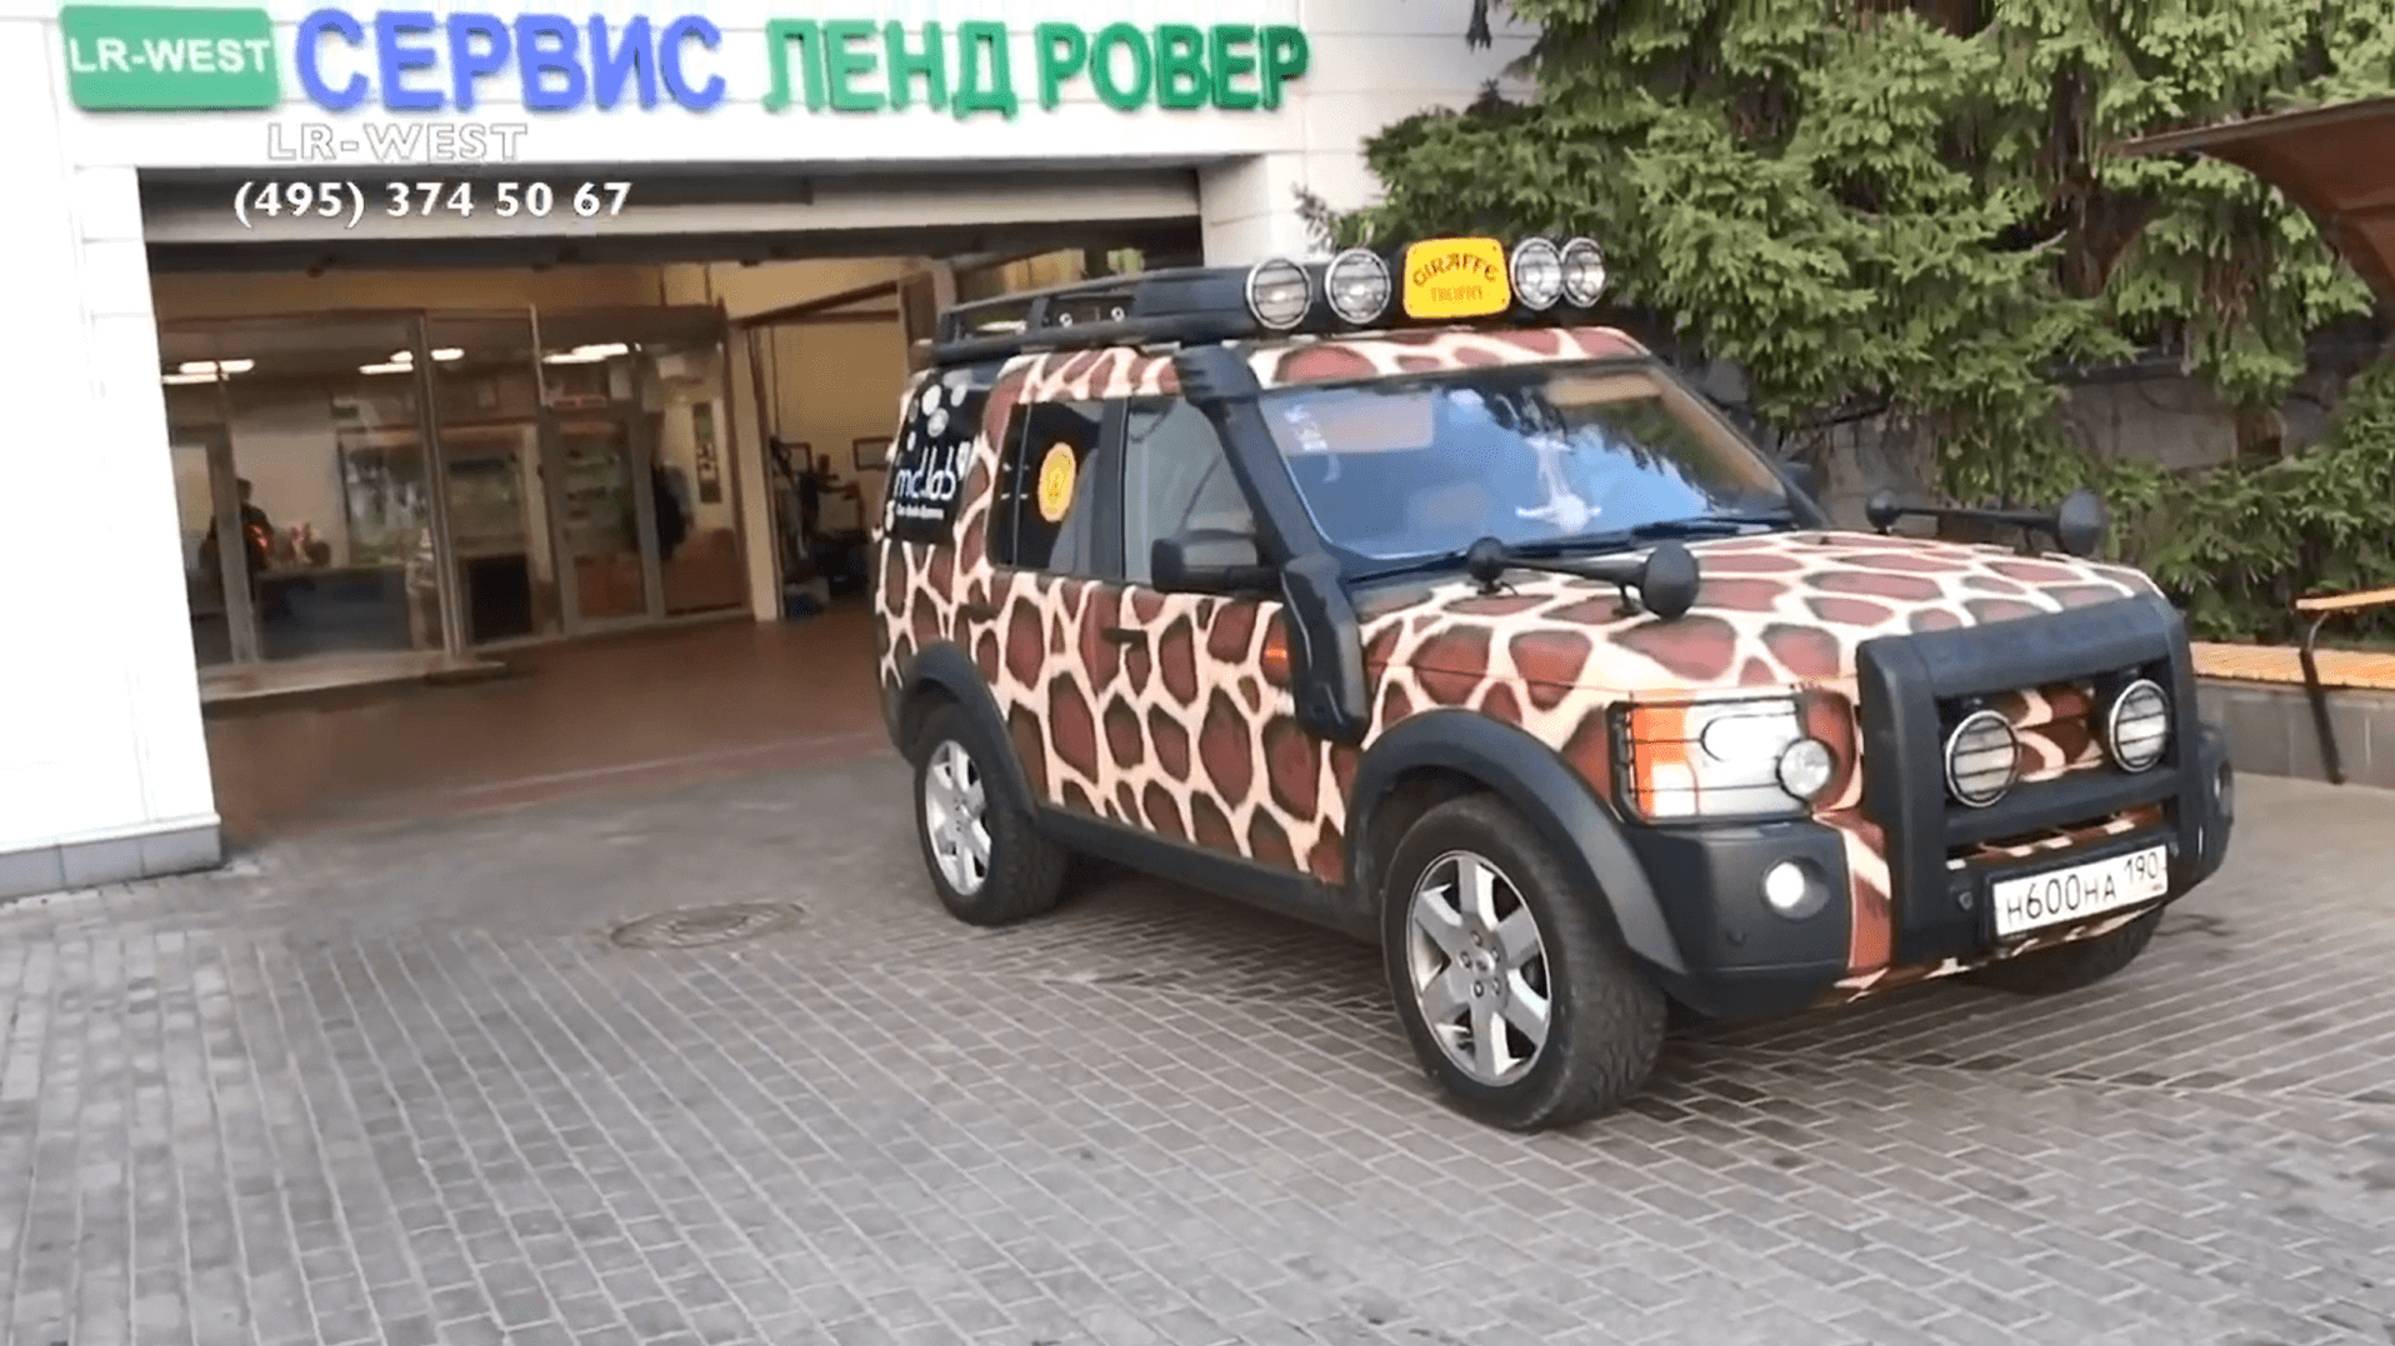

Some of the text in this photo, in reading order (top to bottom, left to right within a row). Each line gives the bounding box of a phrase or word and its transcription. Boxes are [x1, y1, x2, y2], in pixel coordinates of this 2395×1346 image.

[71, 37, 271, 74] LR-WEST
[295, 8, 1310, 119] СЕРВИС ЛЕНД РОВЕР
[1413, 252, 1500, 288] GIRAFFE
